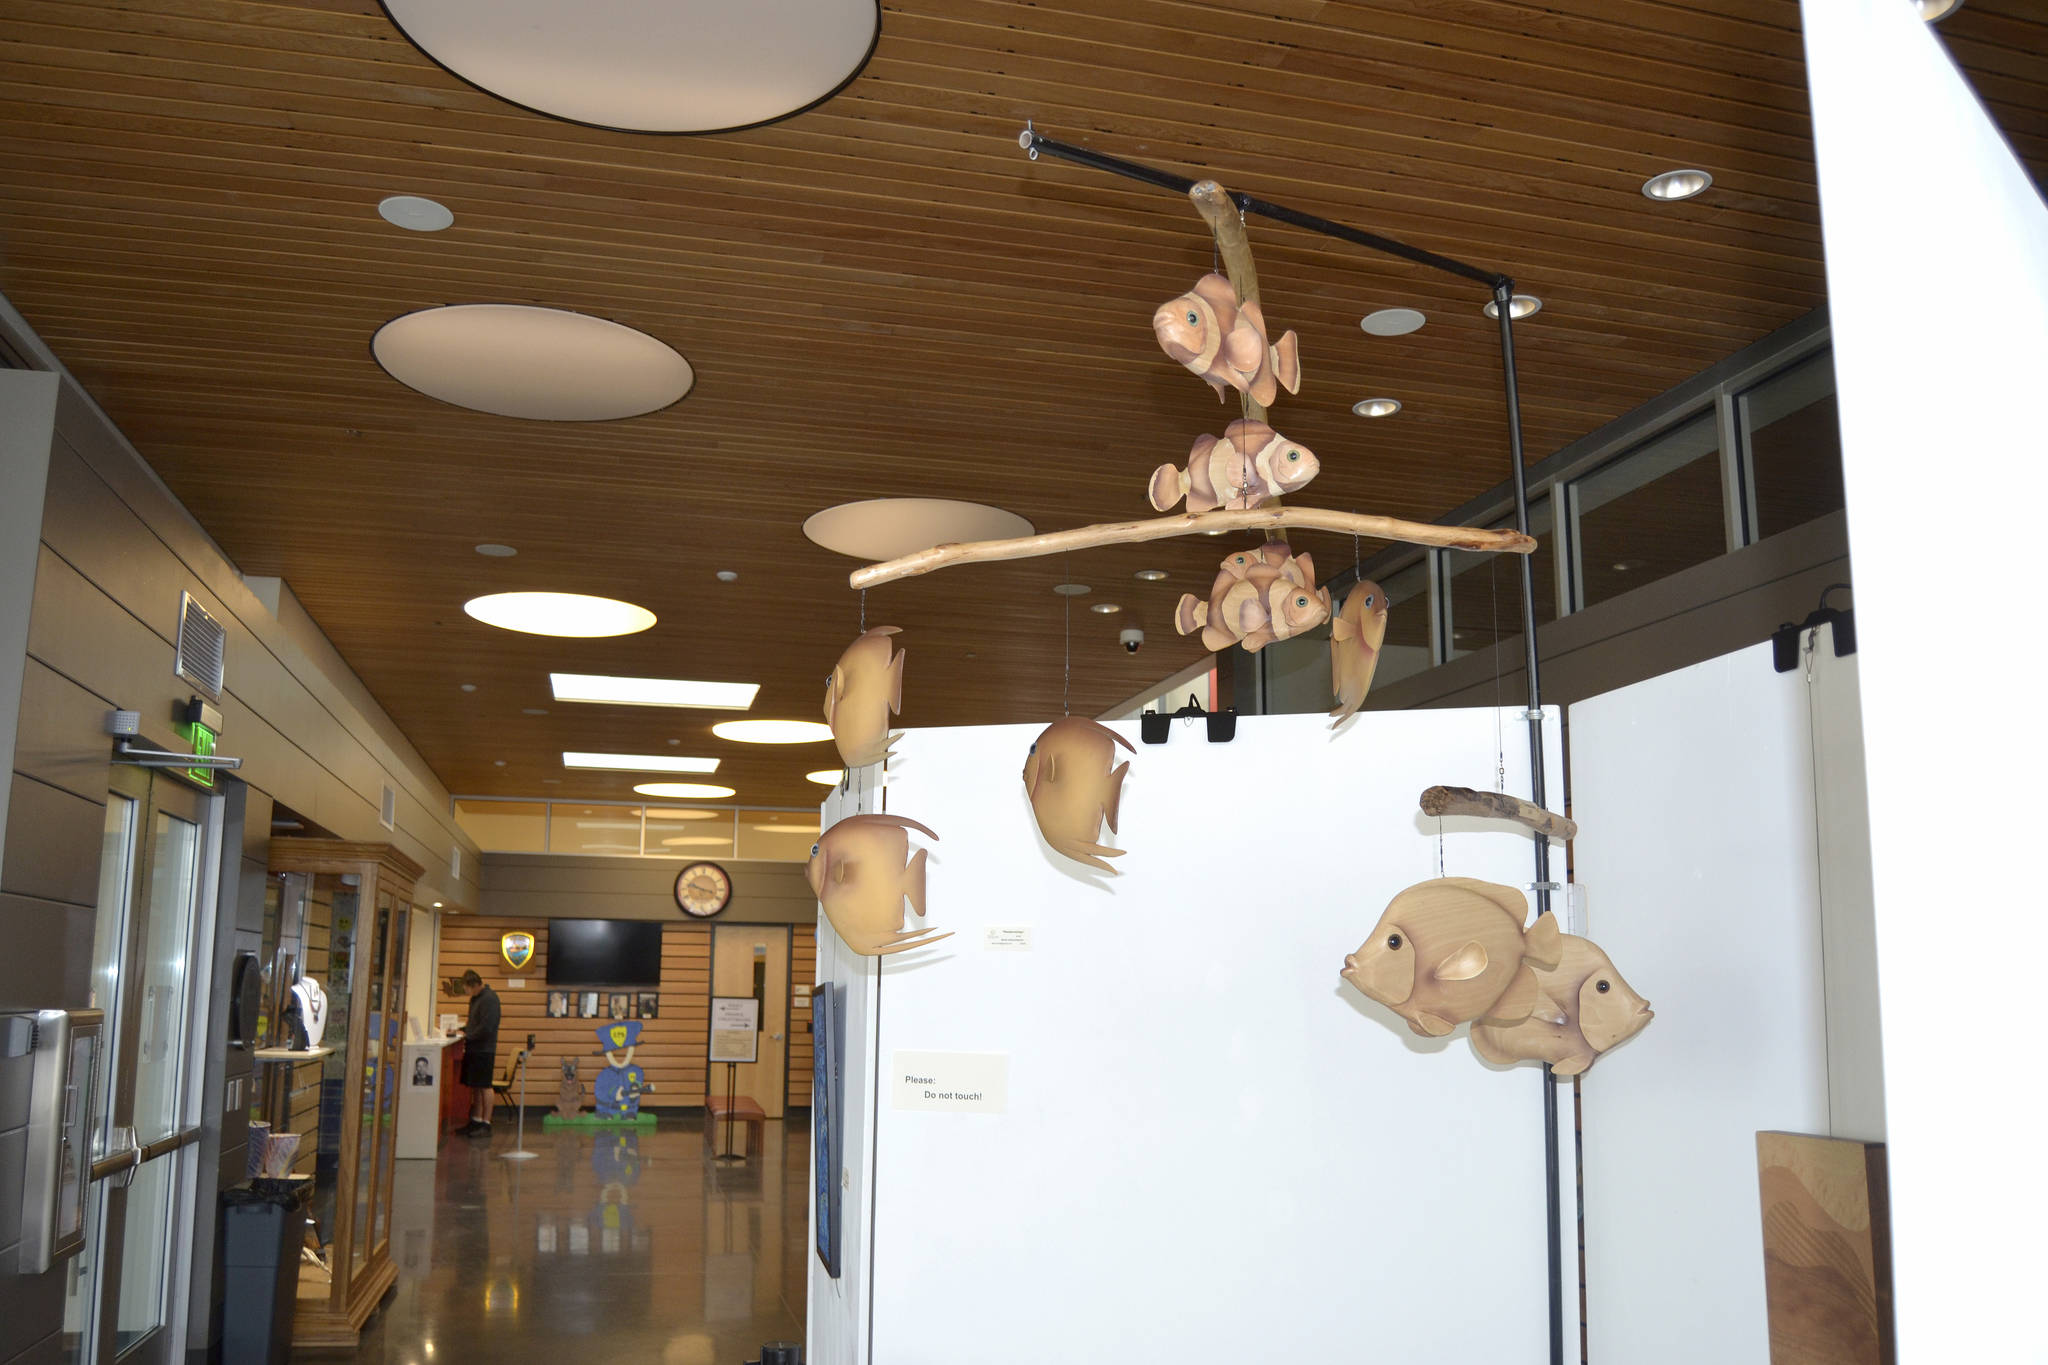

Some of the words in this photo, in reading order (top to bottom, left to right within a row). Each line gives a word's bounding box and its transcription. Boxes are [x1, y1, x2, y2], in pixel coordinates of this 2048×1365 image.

[194, 726, 213, 779] EXIT
[905, 1075, 936, 1085] Please:
[924, 1090, 936, 1099] Do
[938, 1091, 953, 1100] not
[955, 1092, 982, 1101] touch!
